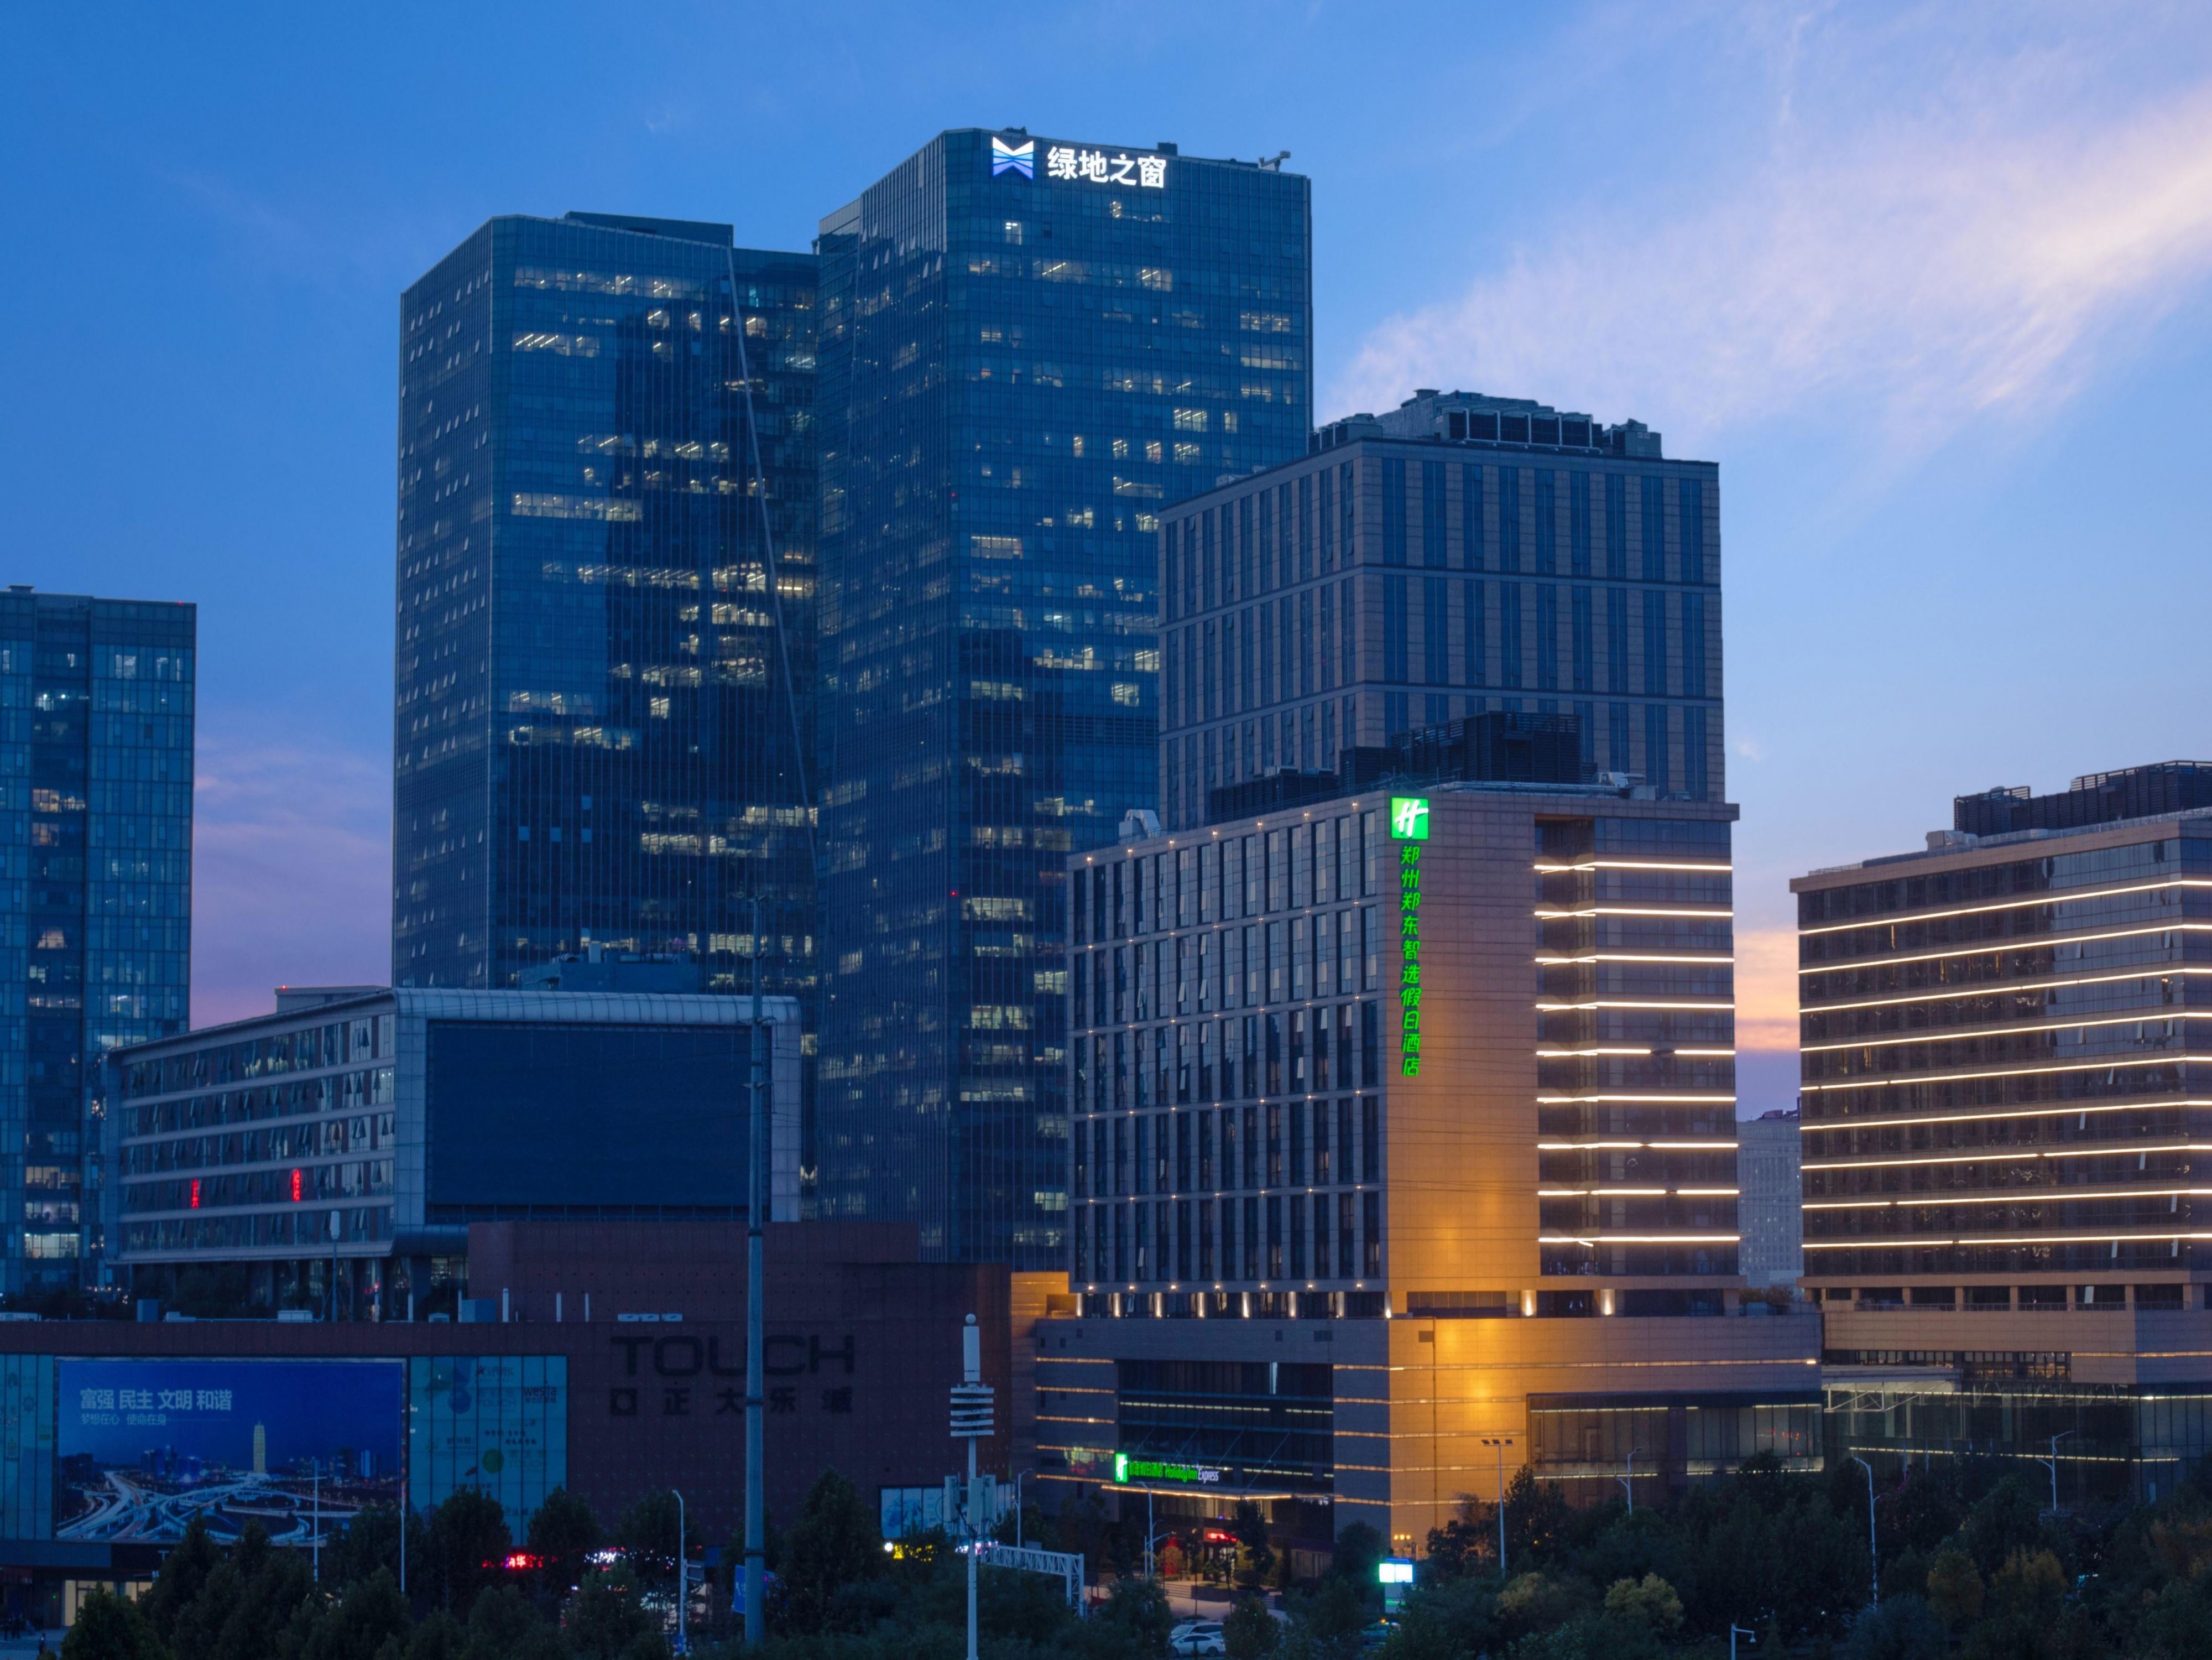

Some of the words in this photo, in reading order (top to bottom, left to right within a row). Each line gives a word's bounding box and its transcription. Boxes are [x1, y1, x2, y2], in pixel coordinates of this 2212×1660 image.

[1048, 146, 1166, 188] 绿地之窗
[1401, 846, 1421, 1076] 郑州郑东智选假日酒店
[611, 1335, 854, 1376] TOUCH
[80, 1388, 114, 1410] 富强
[119, 1389, 154, 1410] 民主
[157, 1389, 192, 1410] 文明
[196, 1389, 232, 1411] 和谐
[81, 1413, 119, 1425] 梦想在心
[127, 1413, 166, 1425] 使命在身
[1198, 1468, 1219, 1484] Express
